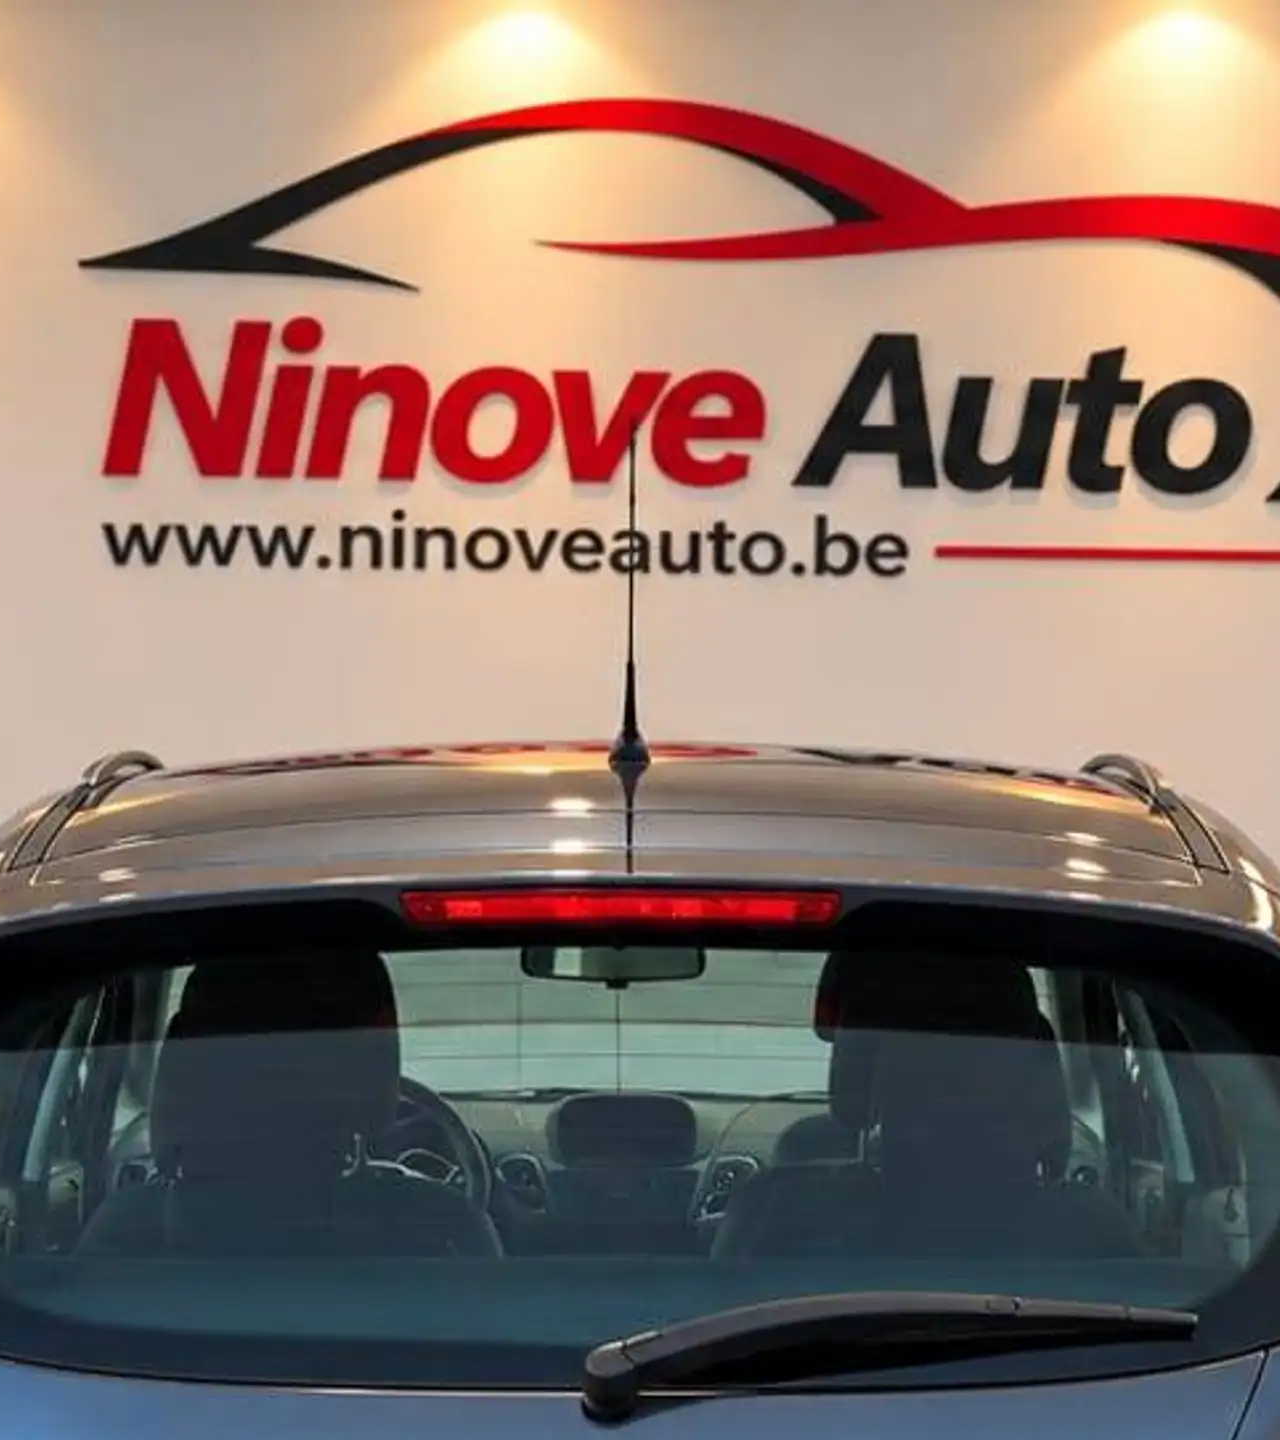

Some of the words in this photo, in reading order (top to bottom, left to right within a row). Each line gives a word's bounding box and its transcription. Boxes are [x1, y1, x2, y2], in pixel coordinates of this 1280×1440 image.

[102, 317, 766, 487] Ninove
[792, 331, 1252, 493] Auto
[102, 510, 909, 578] www.ninoveauto.be
